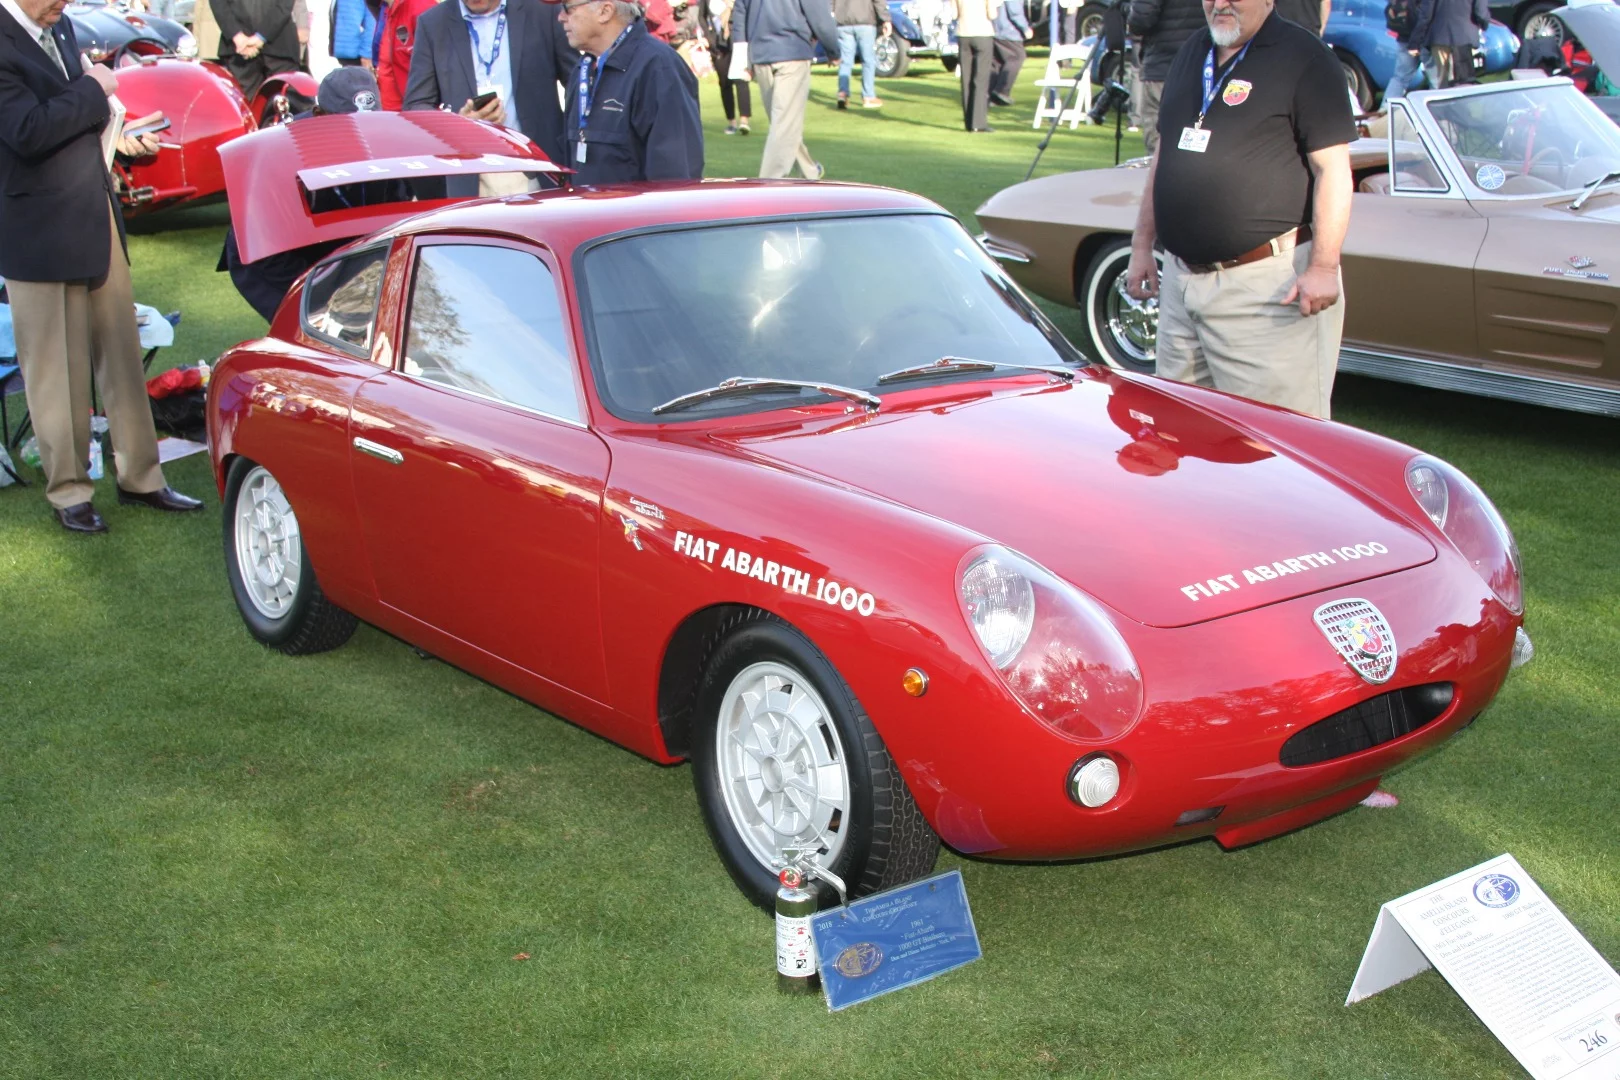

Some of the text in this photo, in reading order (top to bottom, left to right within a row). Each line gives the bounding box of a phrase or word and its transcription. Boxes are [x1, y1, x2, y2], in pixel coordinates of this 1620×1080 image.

[674, 531, 875, 617] FIAT ABARTH 1000
[1180, 541, 1389, 602] FIAT ABARTH 1000
[1419, 896, 1468, 919] AMELIA ISLAND
[1429, 894, 1444, 903] THE
[818, 920, 832, 930] 2018
[911, 918, 923, 927] 1961
[1431, 906, 1469, 926] CONCOURS
[1579, 1030, 1608, 1052] 246
